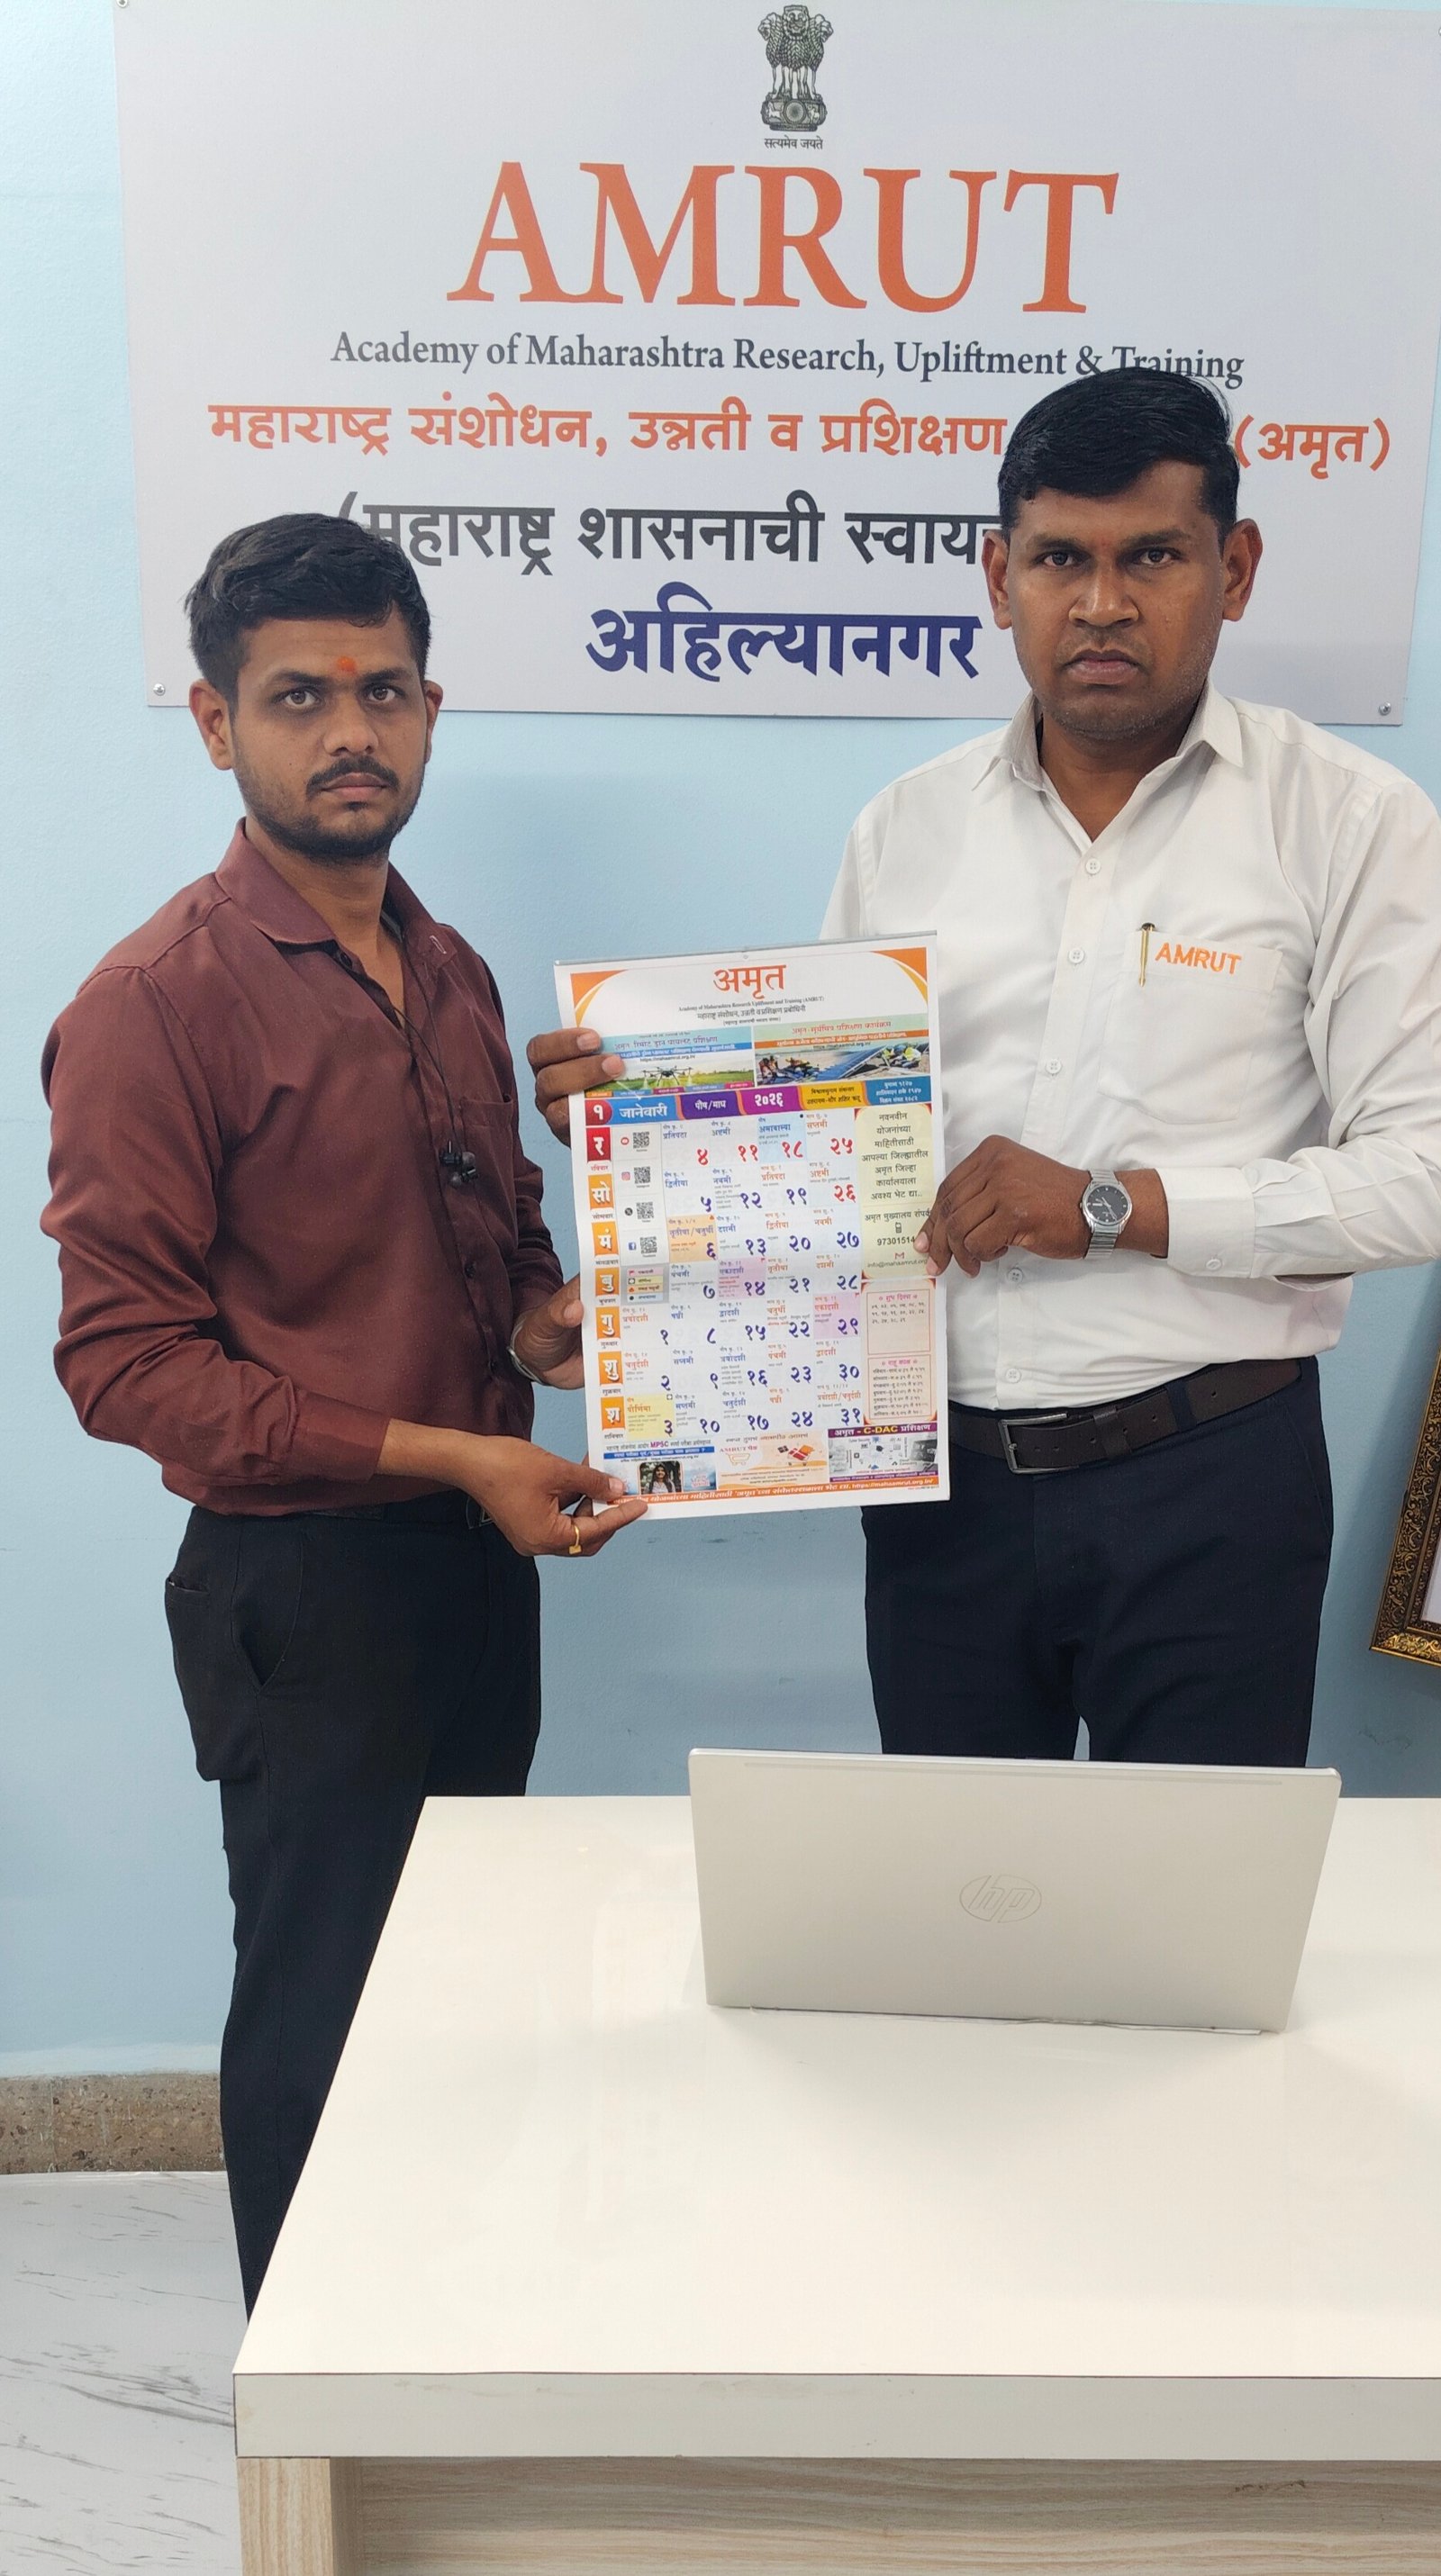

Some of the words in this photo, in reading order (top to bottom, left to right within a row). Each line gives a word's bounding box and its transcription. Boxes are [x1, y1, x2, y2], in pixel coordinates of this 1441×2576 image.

[764, 135, 798, 150] सत्यमेव
[800, 135, 824, 150] जयते
[447, 161, 1119, 314] AMRUT
[330, 332, 478, 374] Academy
[486, 332, 523, 366] of
[525, 334, 726, 370] Maharashtra
[733, 339, 885, 376] Research,
[894, 340, 1067, 383] Upliftment
[1074, 346, 1103, 375] &
[1112, 346, 1245, 389] Training
[208, 403, 391, 456] महाराष्ट्र
[408, 392, 608, 456] संशोधन,
[628, 395, 751, 451] उन्नती
[769, 414, 802, 452] व
[820, 397, 1007, 455] प्रशिक्षण
[1234, 414, 1390, 480] (अमृत)
[577, 489, 825, 565] शासनाची
[845, 511, 1004, 565] स्वाय
[585, 581, 983, 682] अहिल्यानगर
[1155, 942, 1242, 974] AMRUT
[713, 964, 786, 999] अमृत
[620, 1099, 667, 1118] जानेवारी
[755, 1092, 784, 1107] २०२६
[879, 1111, 908, 1122] नवनवीन
[594, 1136, 604, 1155] र
[738, 1144, 758, 1162] ११
[782, 1141, 803, 1159] १८
[830, 1137, 853, 1155] २५
[697, 1149, 709, 1166] ४
[875, 1165, 892, 1176] अमृत
[591, 1180, 611, 1203] सो
[740, 1192, 762, 1209] १२
[786, 1188, 807, 1206] १९
[834, 1184, 856, 1203] २६
[598, 1228, 612, 1251] मं
[746, 1238, 766, 1256] १३
[789, 1234, 811, 1252] २०
[837, 1231, 859, 1249] २७
[877, 1236, 916, 1246] 97301514
[744, 1280, 766, 1297] १४
[789, 1277, 811, 1294] २१
[837, 1274, 858, 1290] २८
[703, 1285, 715, 1299] ७
[600, 1314, 614, 1336] गु
[745, 1324, 766, 1341] १५
[789, 1321, 811, 1338] २२
[838, 1317, 858, 1335] २९
[660, 1329, 669, 1345] १
[707, 1327, 717, 1344] ८
[711, 1372, 719, 1389] ९
[748, 1369, 768, 1387] १६
[791, 1366, 812, 1384] २३
[838, 1363, 860, 1381] ३०
[661, 1375, 671, 1391] २
[748, 1415, 769, 1431] १७
[791, 1411, 813, 1428] २४
[840, 1407, 861, 1426] ३१
[664, 1419, 673, 1437] ३
[700, 1418, 720, 1434] १०
[864, 1425, 898, 1434] C-DAC
[967, 1875, 1036, 1923] hp
